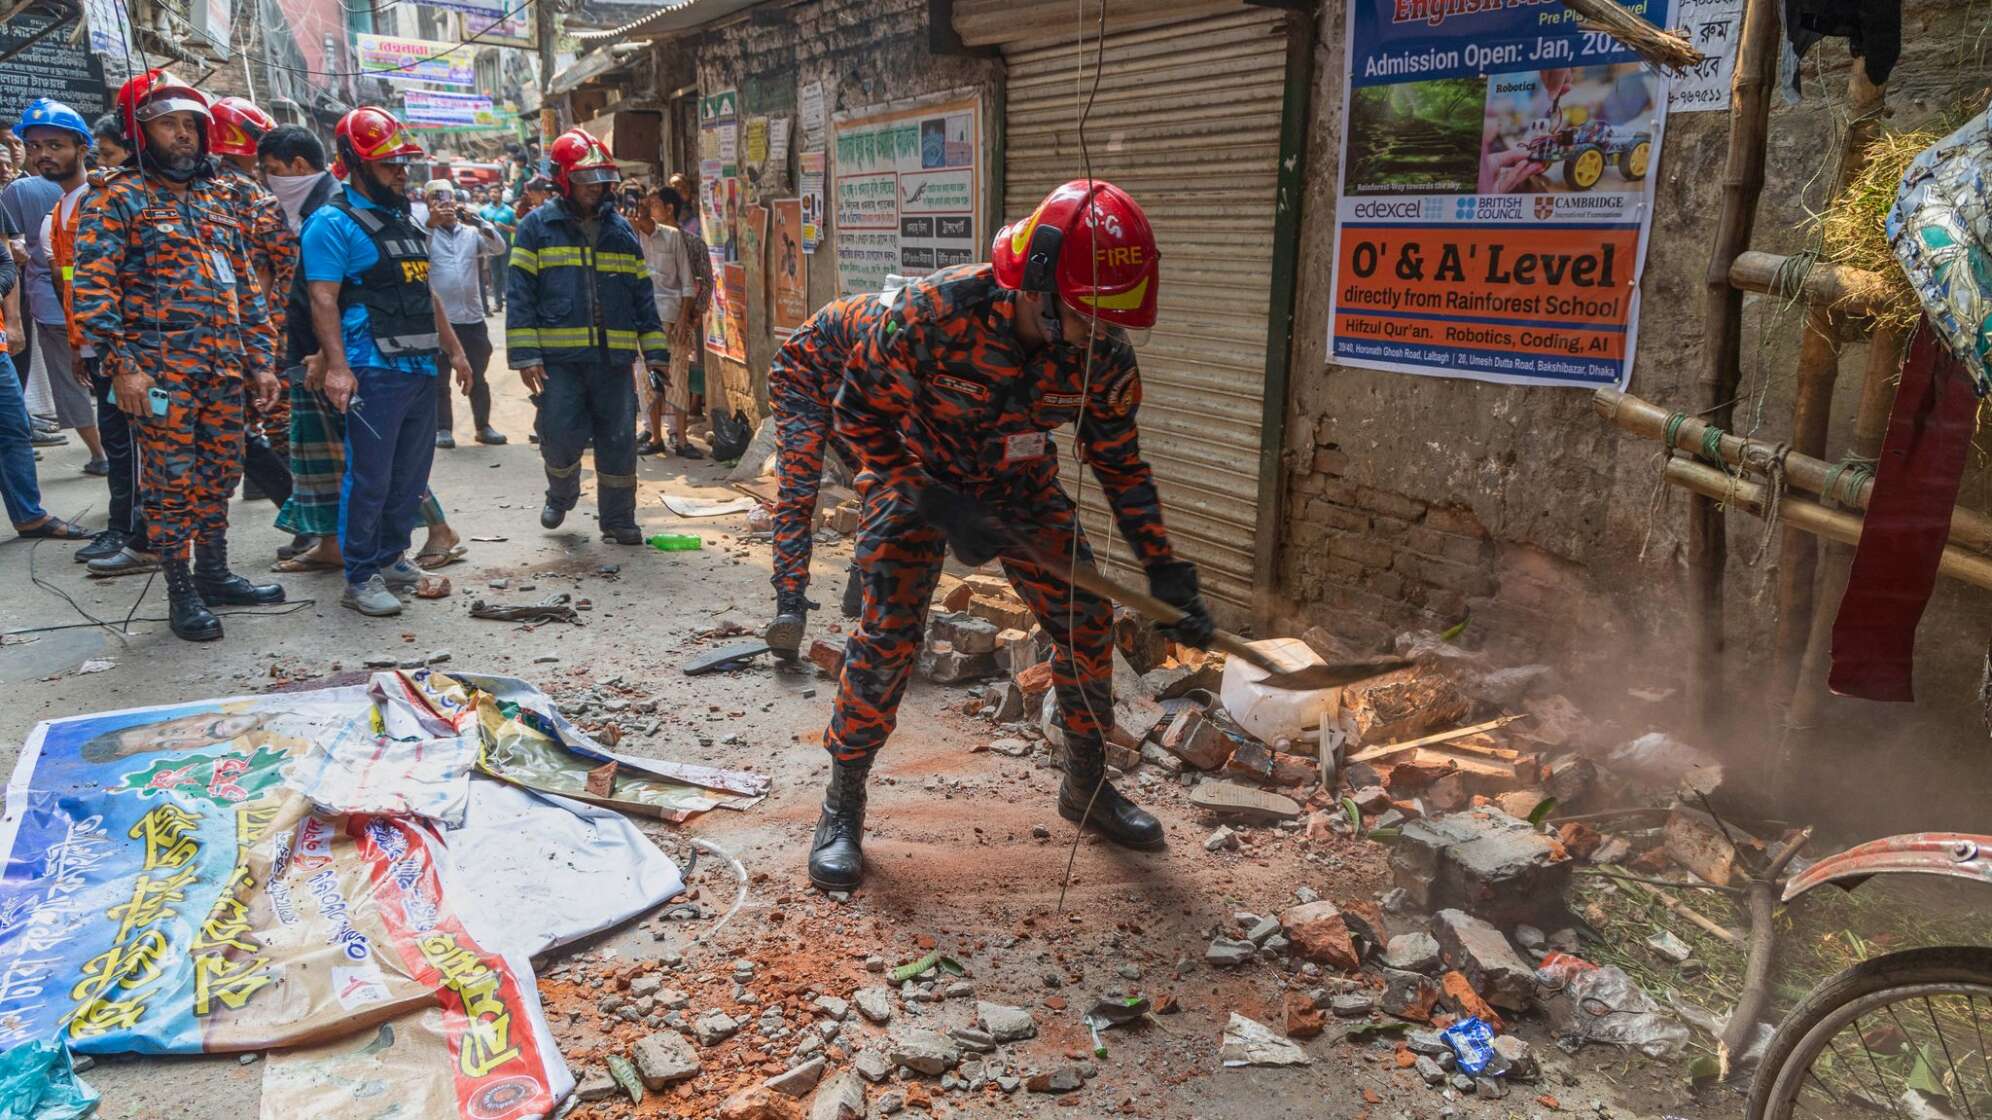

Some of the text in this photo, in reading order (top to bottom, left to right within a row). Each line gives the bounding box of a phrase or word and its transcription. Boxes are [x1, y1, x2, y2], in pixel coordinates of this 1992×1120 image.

[1539, 12, 1560, 25] Pre
[1364, 31, 1637, 78] Admission Open: Jan, 202
[1496, 81, 1537, 93] Robotics
[1355, 200, 1421, 218] edexcel
[1478, 197, 1522, 208] BRITISH
[1555, 196, 1624, 209] CAMBRIDGE
[1476, 208, 1523, 219] COUNCIL
[1096, 246, 1144, 266] FIRE
[1395, 242, 1424, 282] &
[1484, 243, 1616, 288] Level
[1344, 286, 1619, 318] directly from Rainforest School
[1345, 319, 1381, 334] Hifzul
[1445, 327, 1516, 347] Robotics,
[1520, 332, 1583, 354] Coding,
[1588, 338, 1608, 352] AI
[1469, 354, 1493, 368] Umesh
[1515, 358, 1536, 372] Road,
[1589, 364, 1616, 377] Dhaka
